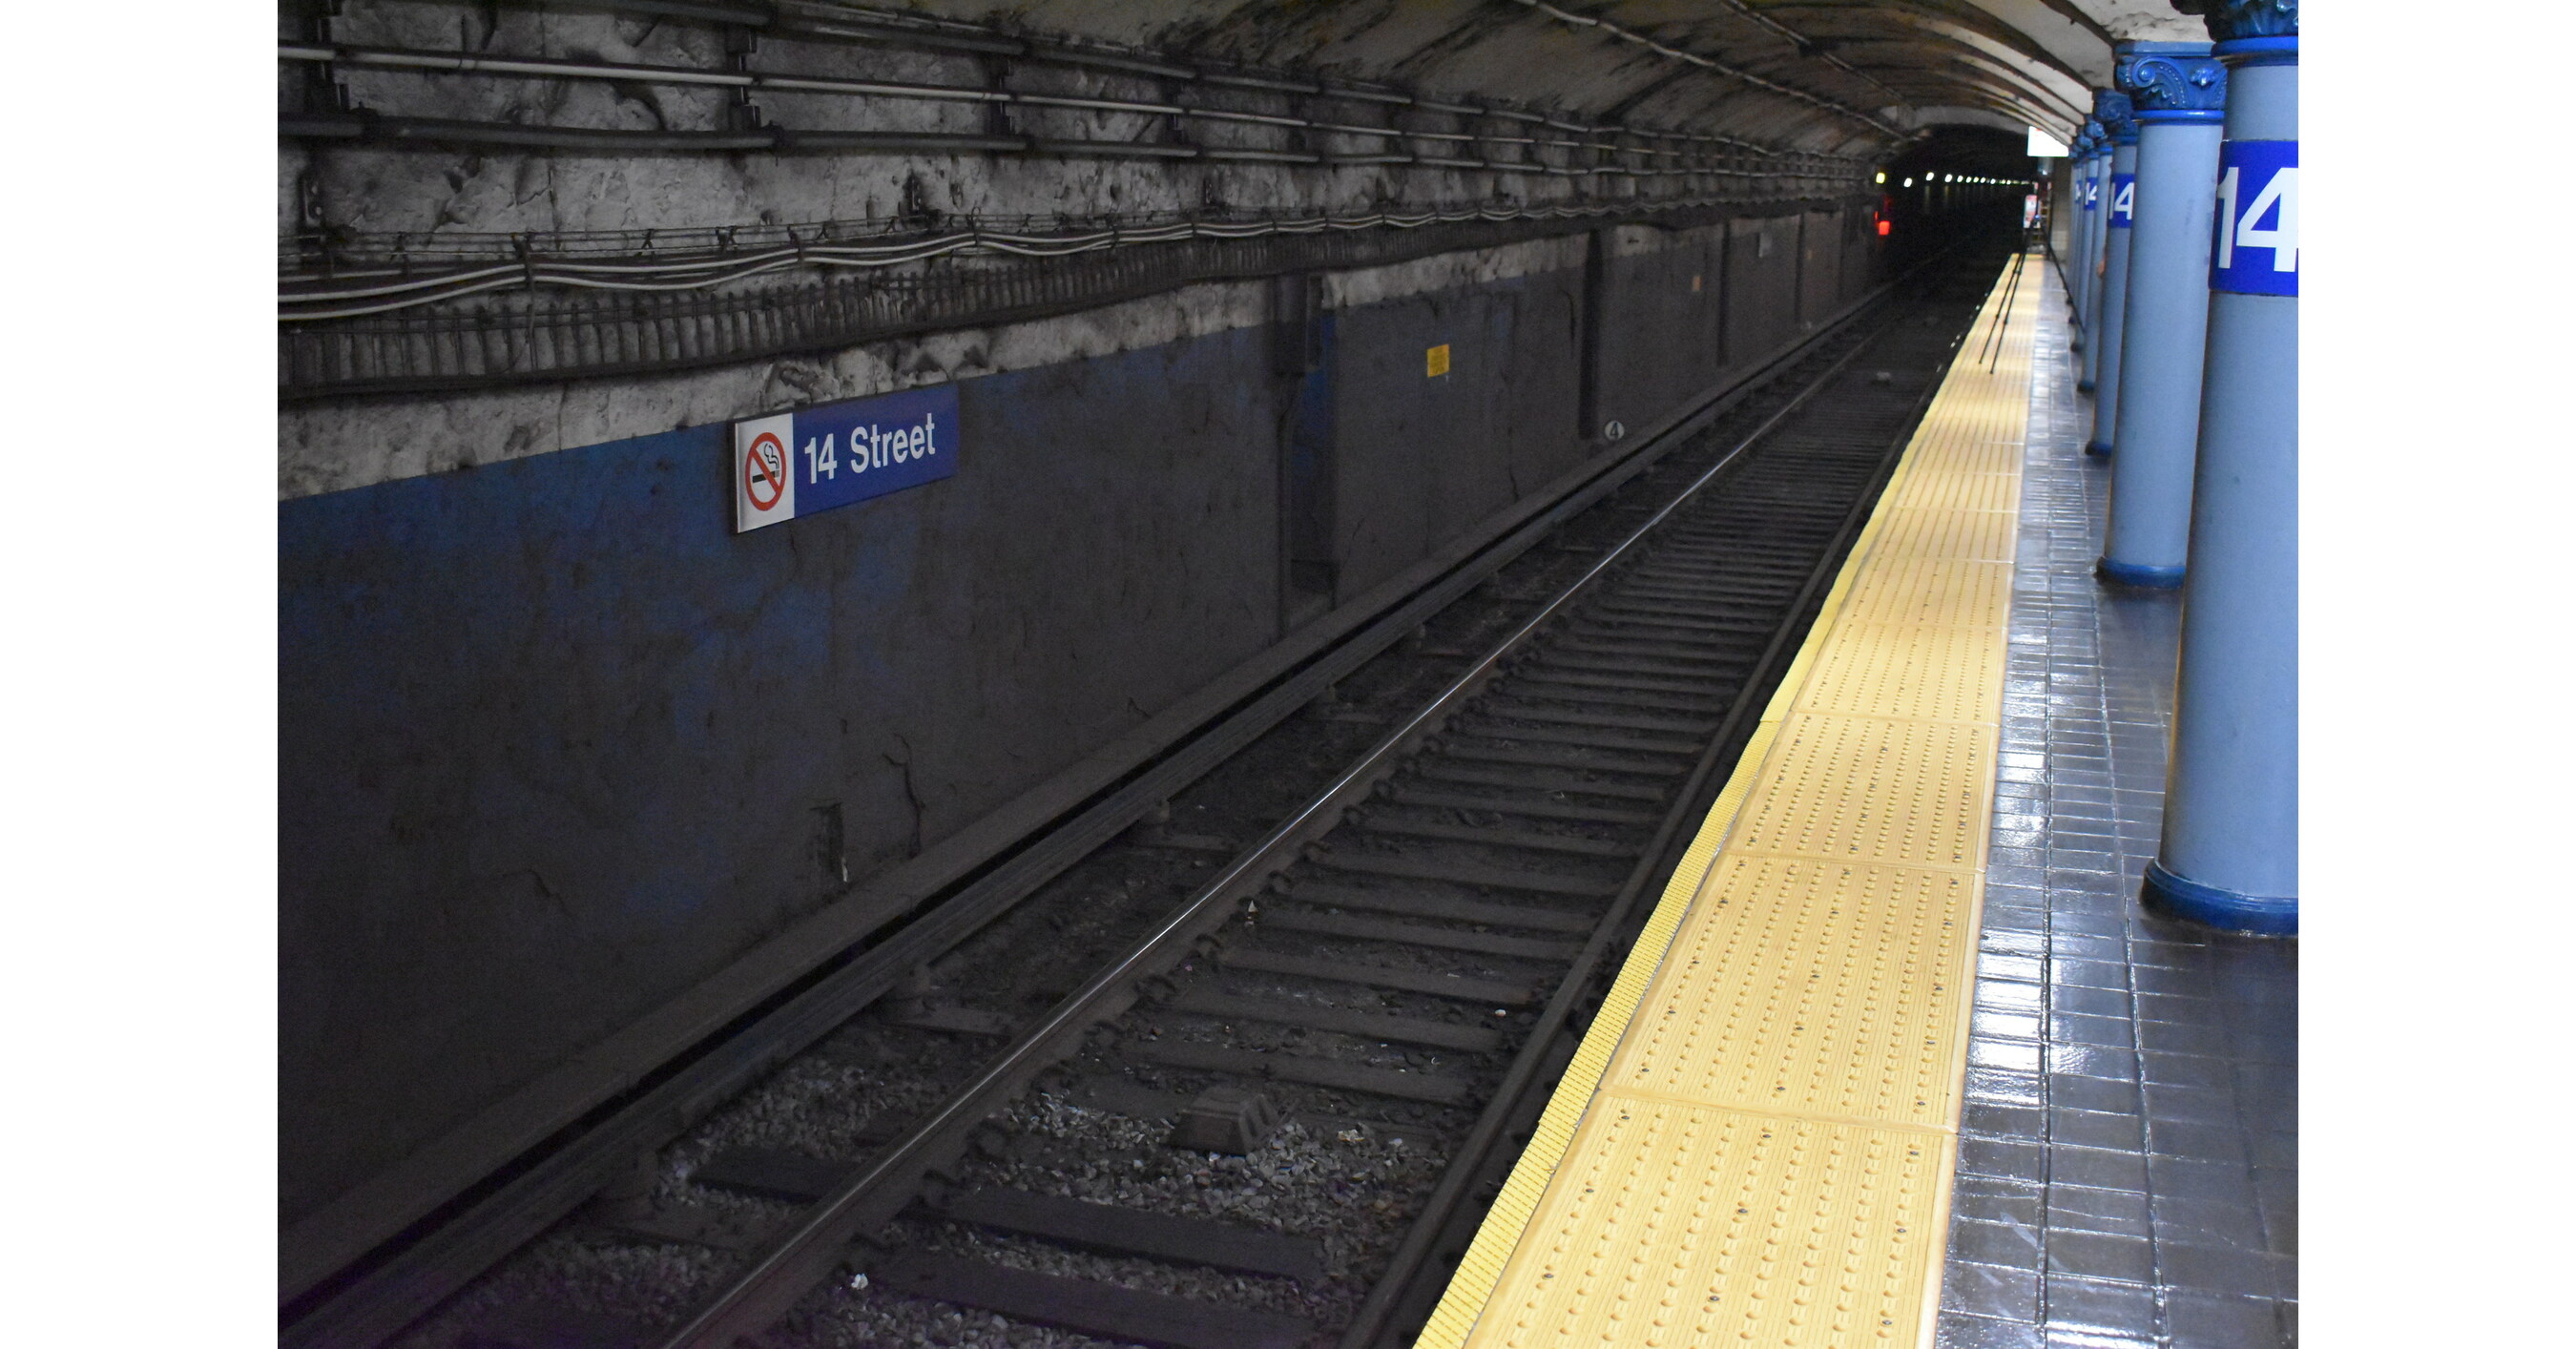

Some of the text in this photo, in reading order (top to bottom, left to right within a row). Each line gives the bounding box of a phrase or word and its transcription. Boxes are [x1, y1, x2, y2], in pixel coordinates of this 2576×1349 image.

[2109, 182, 2134, 220] 14
[2216, 166, 2298, 273] 14
[804, 412, 935, 484] 14 Street
[1610, 422, 1619, 441] 4
